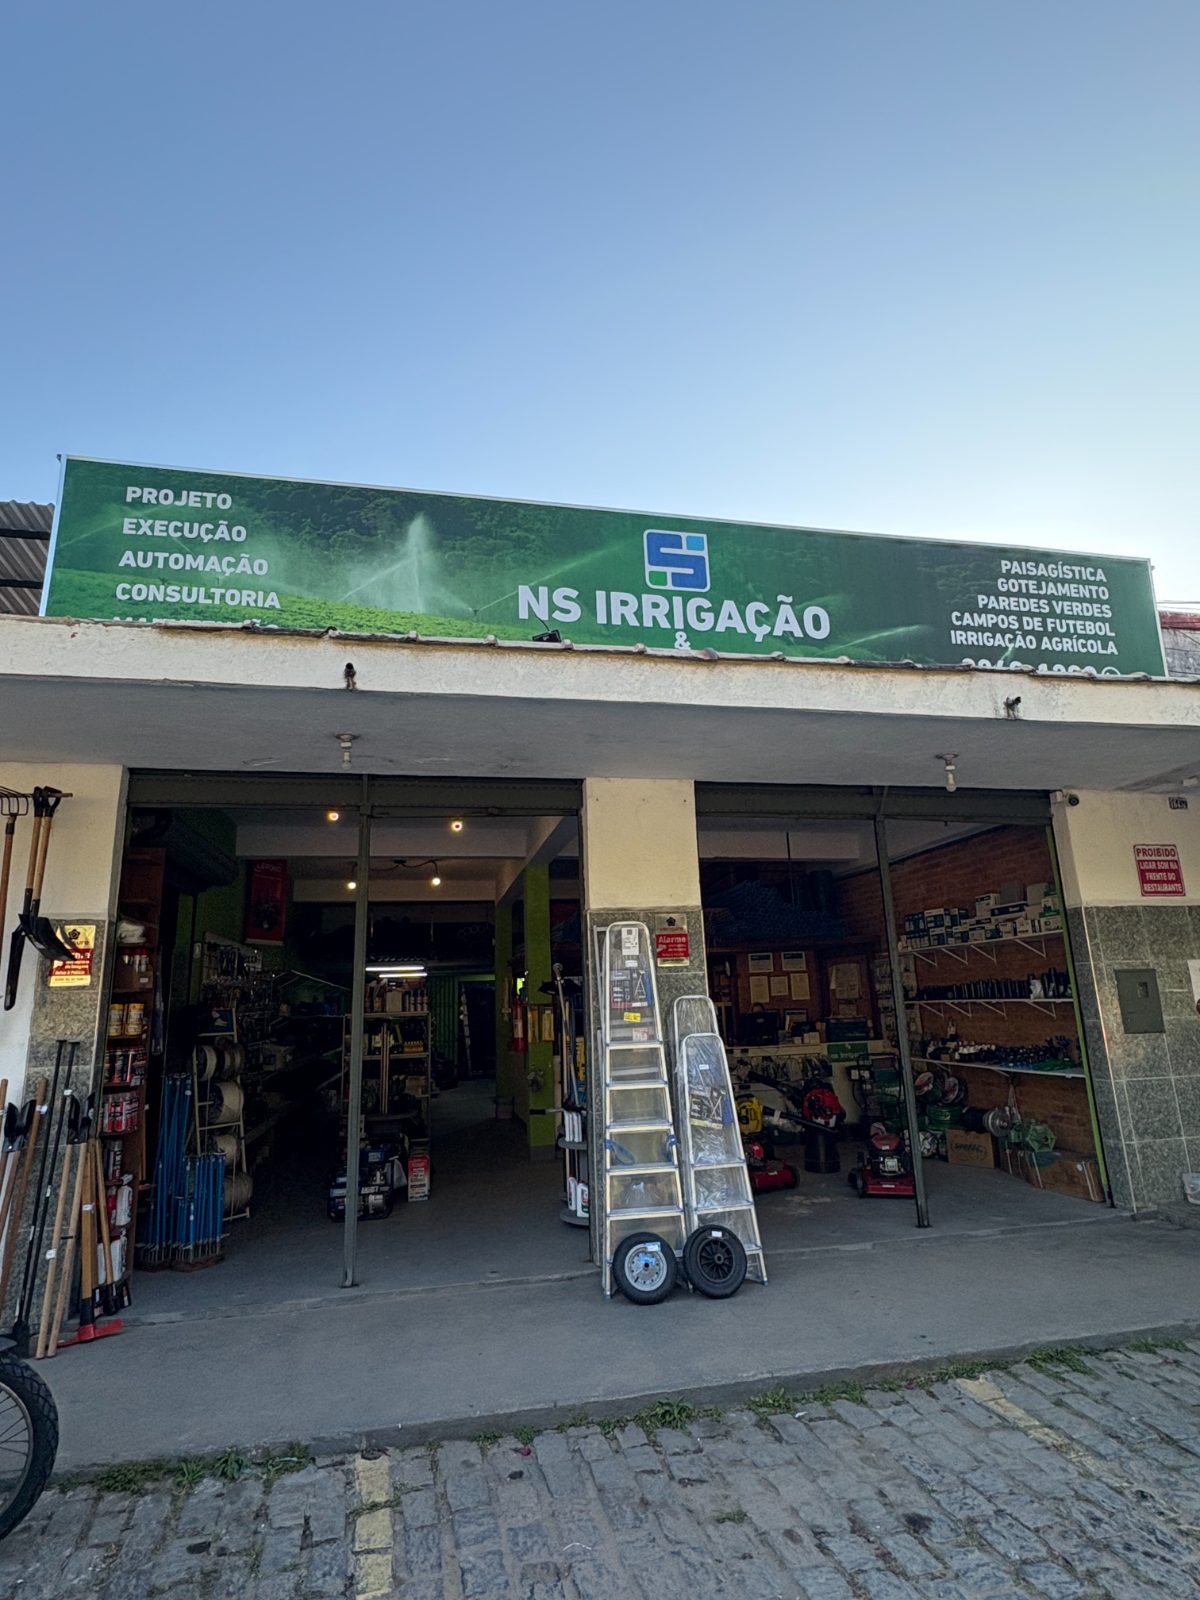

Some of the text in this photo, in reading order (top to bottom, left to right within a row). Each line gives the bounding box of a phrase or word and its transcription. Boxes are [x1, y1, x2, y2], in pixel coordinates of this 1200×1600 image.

[125, 486, 233, 510] PROJETO
[122, 517, 247, 543] EXECUÇÃO
[118, 550, 269, 576] AUTOMAÇÃO
[1000, 560, 1107, 582] PAISAGÍSTICA
[115, 582, 281, 609] CONSULTORIA
[997, 578, 1109, 600] GOTEJAMENTO
[518, 585, 831, 643] NS IRRIGAÇÃO
[977, 595, 1112, 619] PAREDES VERDES
[951, 611, 1116, 637] CAMPOS DE FUTEBOL
[674, 631, 691, 650] &
[950, 630, 1119, 655] IRRIGAÇÃO AGRÍCOLA
[1136, 848, 1176, 858] PROIBIDO
[1139, 861, 1157, 869] LIGAR
[1145, 872, 1167, 881] FRENTE
[1143, 883, 1183, 892] RESTAURANTE
[658, 935, 686, 944] Alarme
